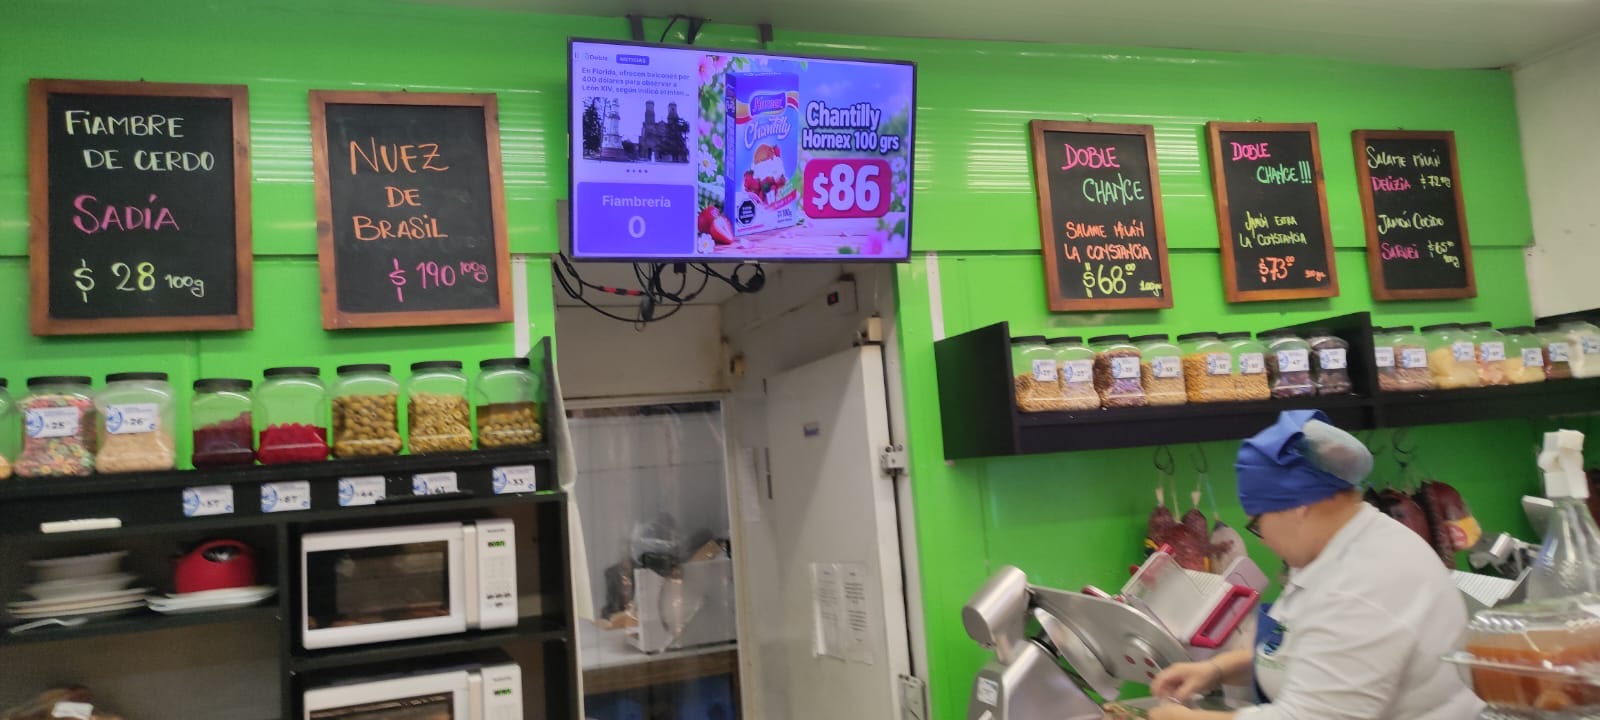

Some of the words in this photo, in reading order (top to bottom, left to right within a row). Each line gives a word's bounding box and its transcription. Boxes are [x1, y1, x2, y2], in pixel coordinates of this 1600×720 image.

[806, 100, 881, 131] Chantilly
[802, 128, 851, 151] Hornex
[853, 129, 880, 152] 100
[879, 134, 900, 155] grs
[1230, 142, 1272, 161] DOBLE
[83, 149, 124, 170] DE
[133, 150, 215, 172] CERDO
[350, 136, 450, 176] NUEZ
[1061, 143, 1120, 171] DOBLE
[384, 185, 422, 208] DE
[812, 163, 881, 212] $86
[1082, 172, 1145, 206] CHANCE
[72, 193, 180, 235] SADÍA
[628, 215, 647, 239] 0
[1066, 221, 1107, 240] SALAME
[1239, 232, 1253, 248] LA
[1064, 242, 1081, 263] LA
[1086, 242, 1152, 262] CONSTANCIA
[72, 257, 96, 304] $
[111, 261, 156, 292] 28
[164, 273, 206, 298] 100g
[388, 257, 407, 303] $
[416, 260, 456, 290] 190
